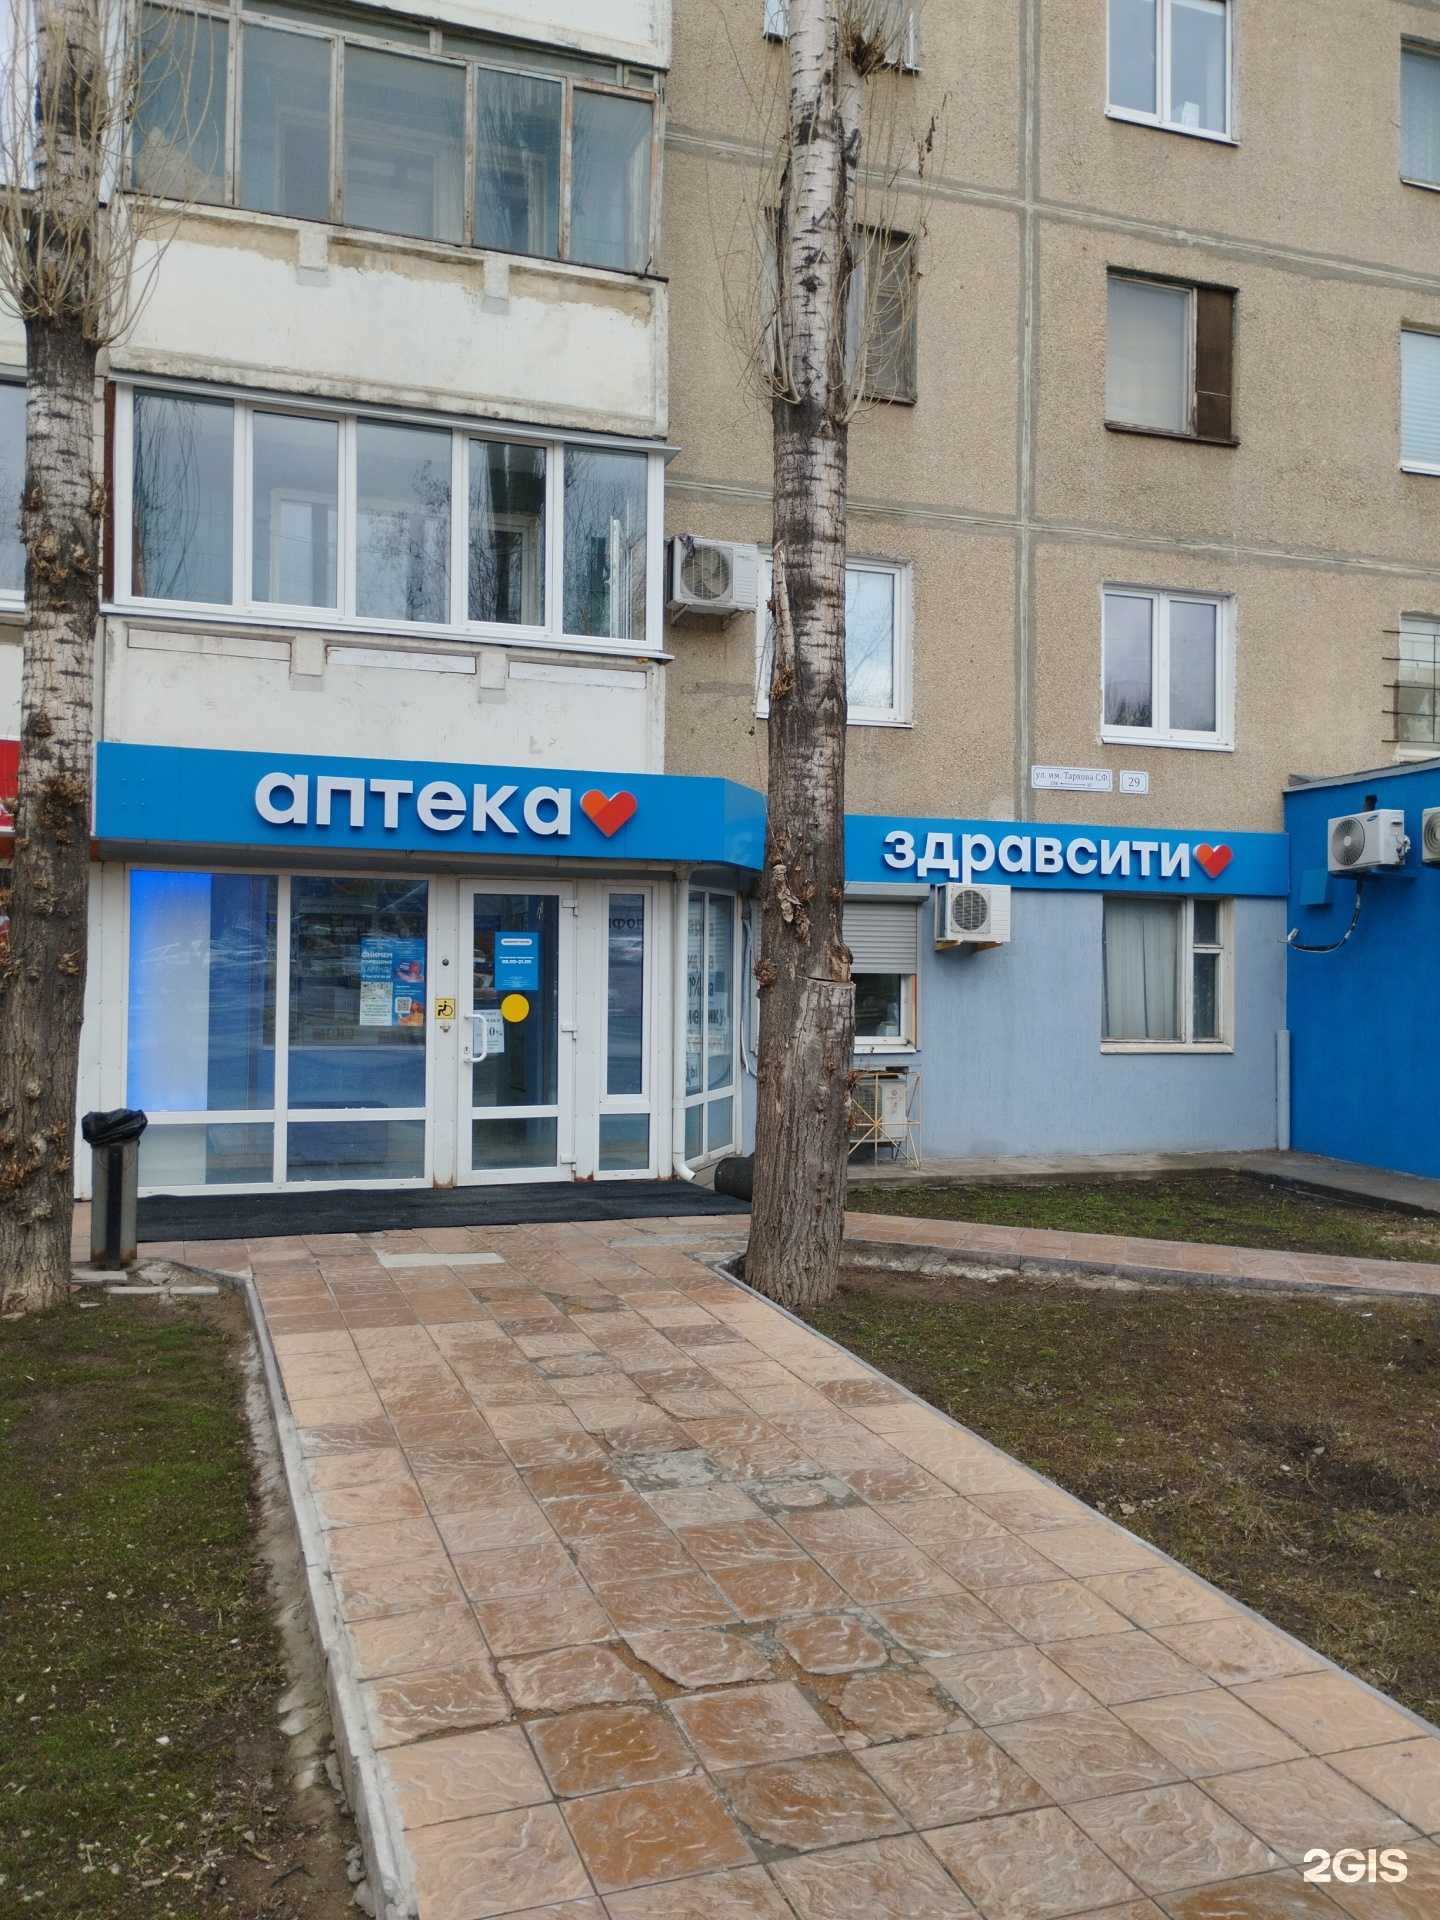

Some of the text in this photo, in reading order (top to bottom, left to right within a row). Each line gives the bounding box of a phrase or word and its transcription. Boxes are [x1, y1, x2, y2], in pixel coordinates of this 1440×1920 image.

[256, 773, 571, 835] аптека
[1127, 776, 1141, 788] 29
[884, 830, 1190, 884] здравсити
